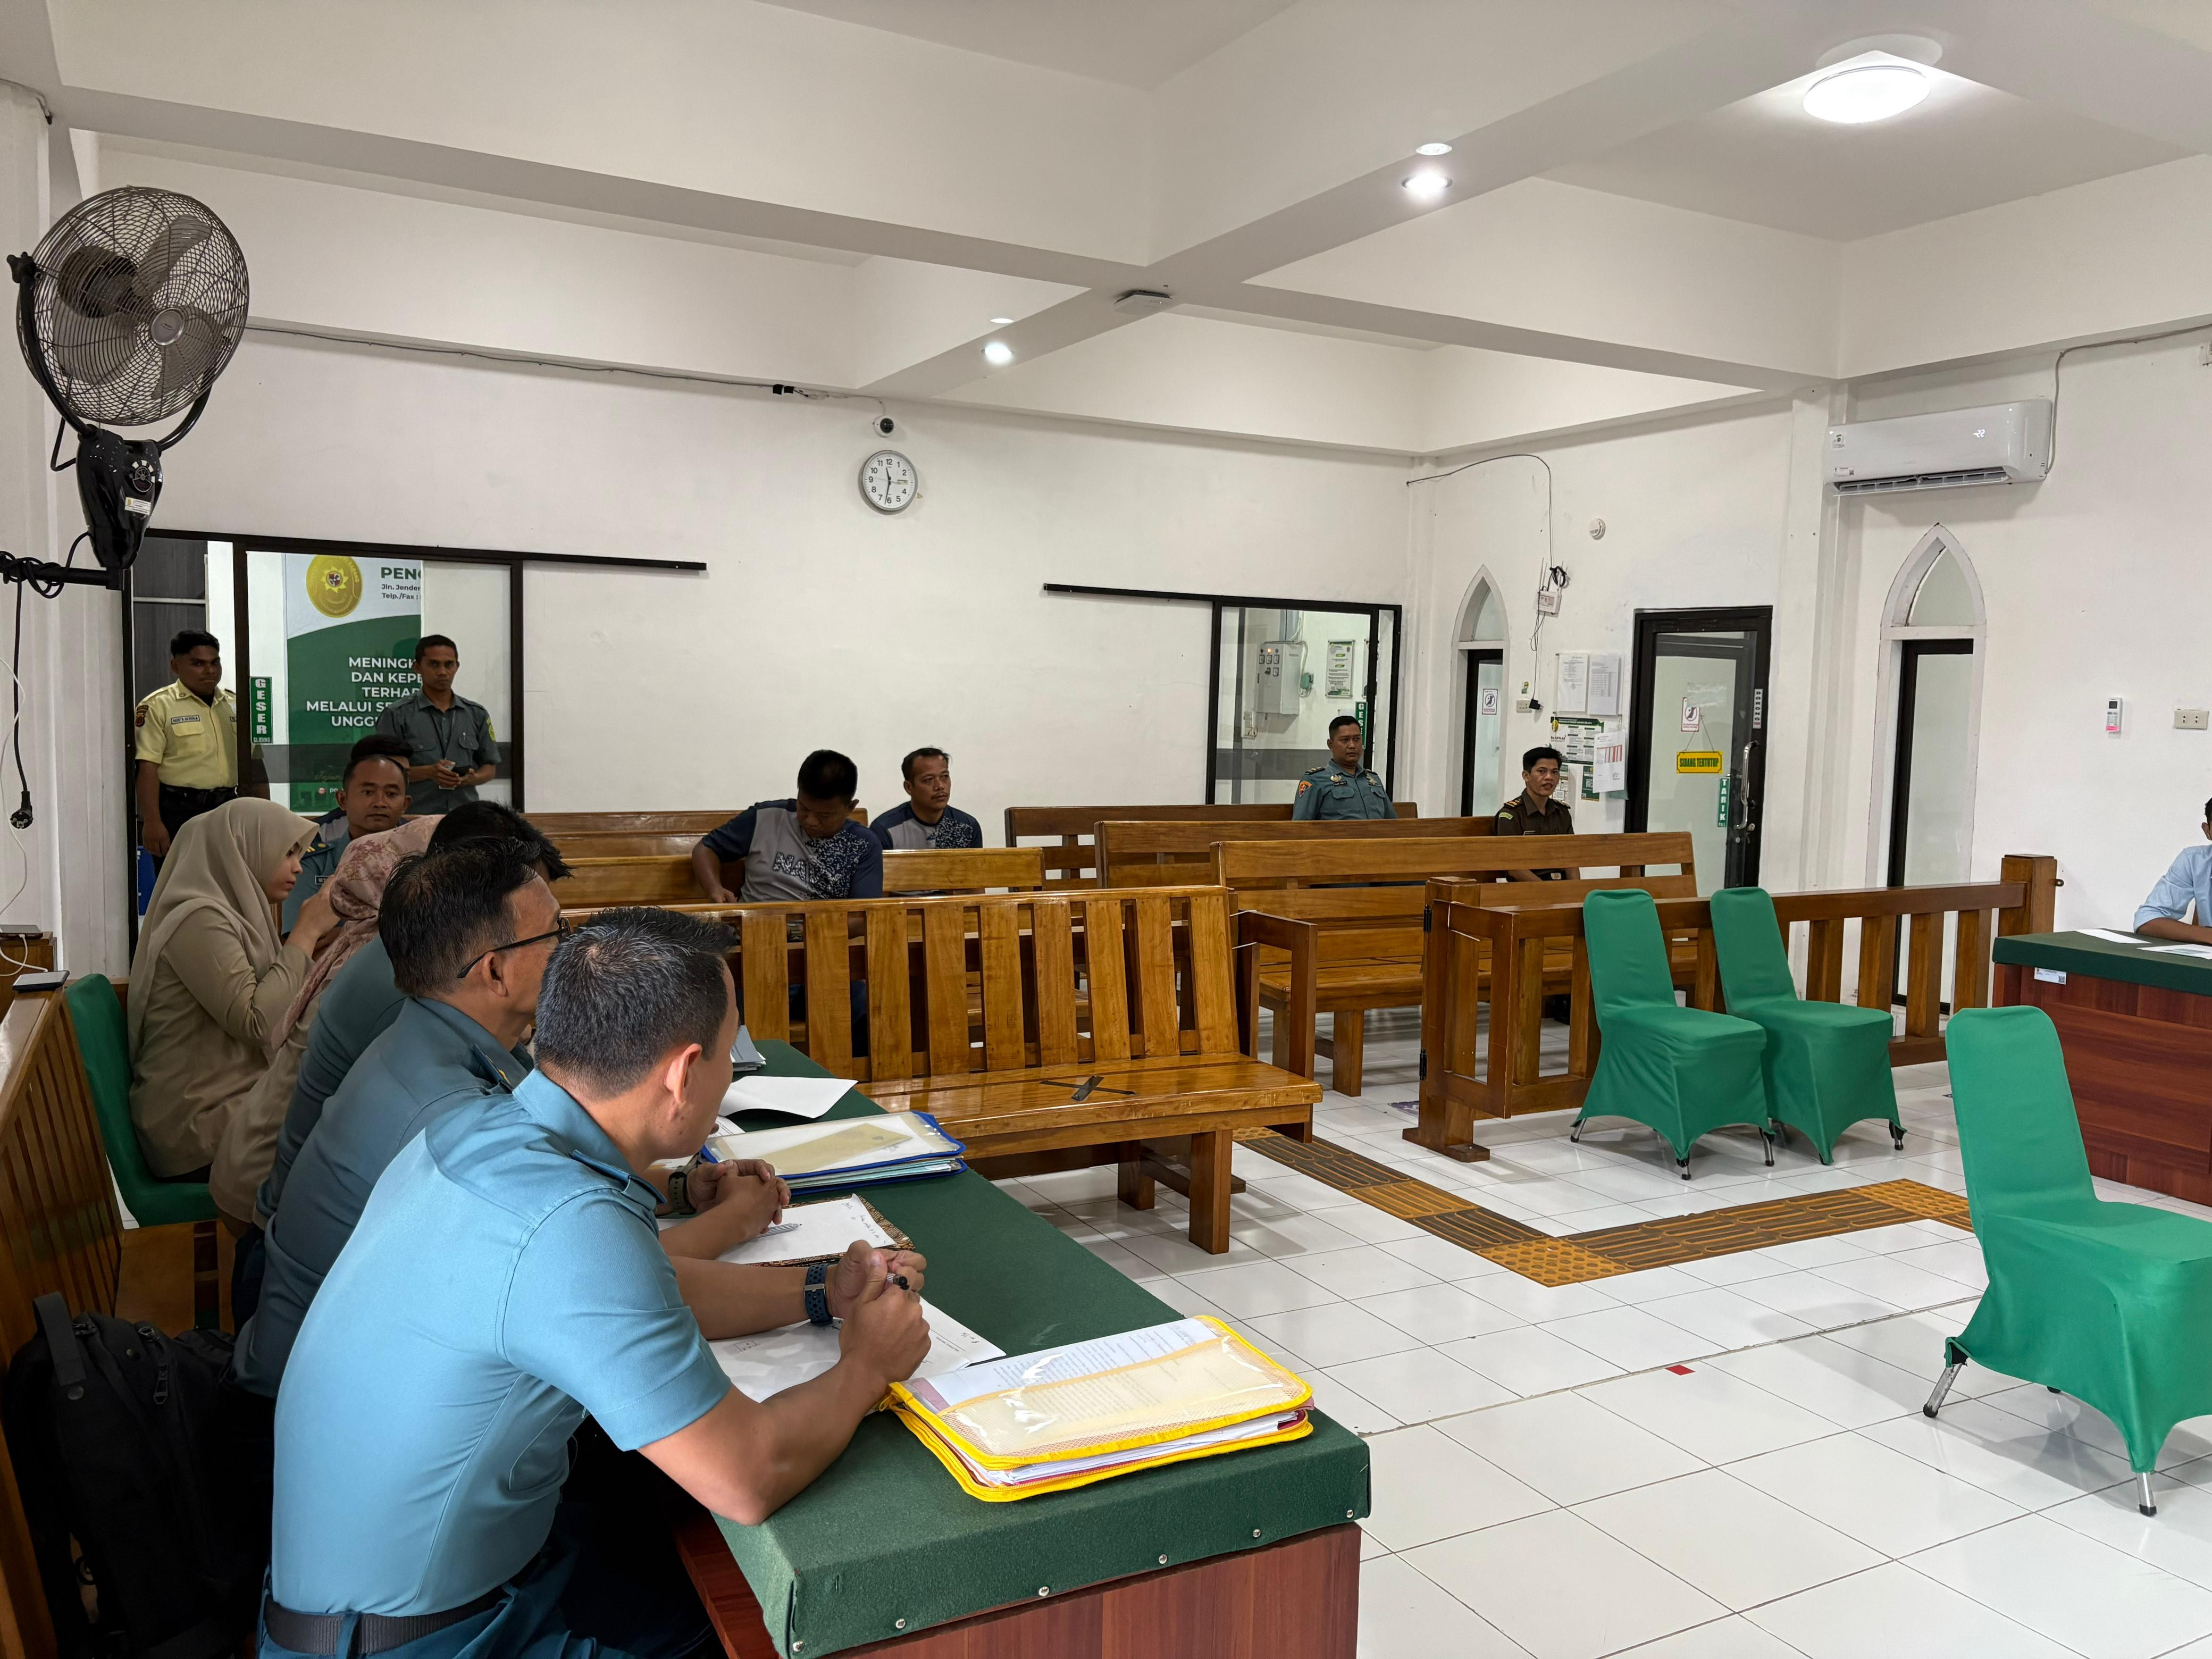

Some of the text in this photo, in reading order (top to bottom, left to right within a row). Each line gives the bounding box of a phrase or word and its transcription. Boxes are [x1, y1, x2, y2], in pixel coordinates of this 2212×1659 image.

[381, 567, 421, 580] PEN
[351, 672, 383, 683] DAN
[255, 678, 267, 734] GESER
[306, 701, 371, 712] MELALUI
[1719, 779, 1728, 820] TARIK
